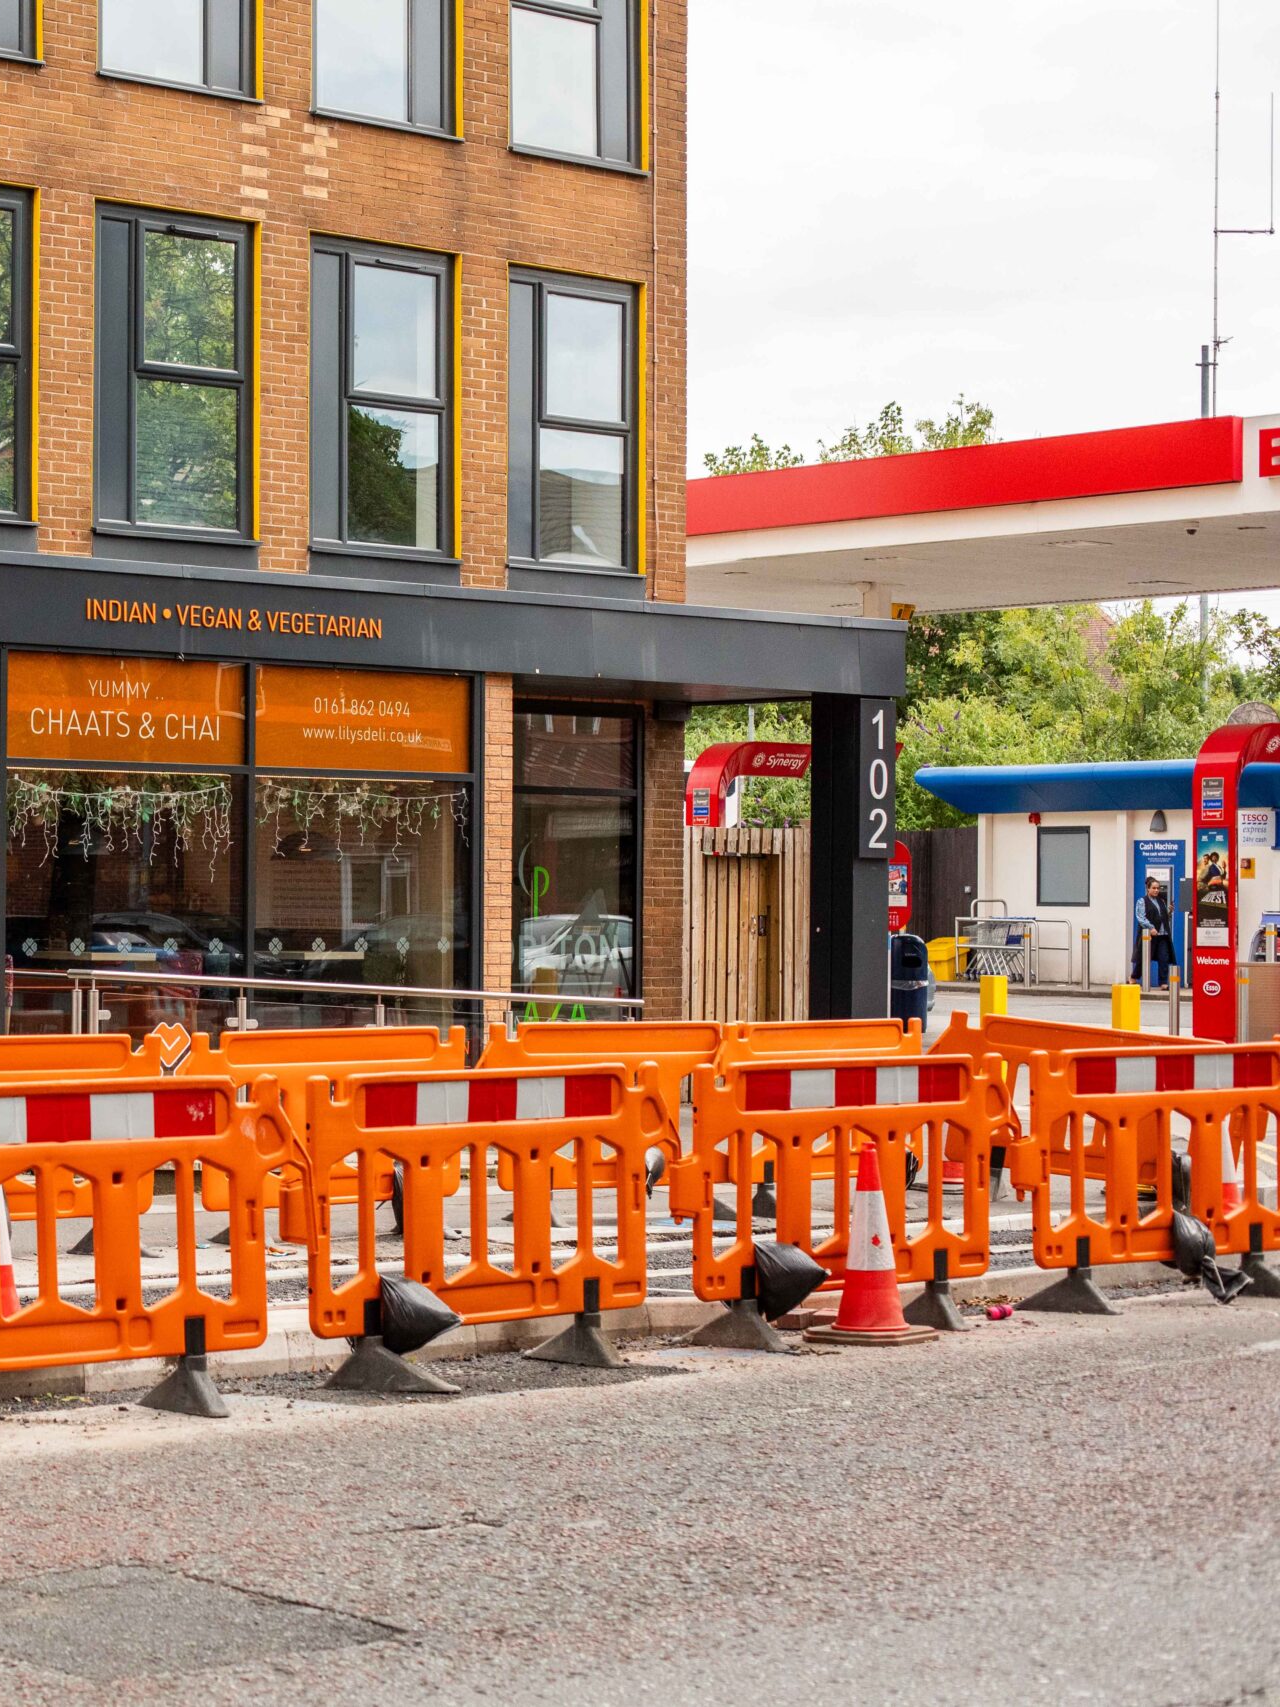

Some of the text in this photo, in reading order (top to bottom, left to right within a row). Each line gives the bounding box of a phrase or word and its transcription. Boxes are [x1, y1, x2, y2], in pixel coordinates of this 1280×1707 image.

[86, 598, 383, 640] INDIAN VEGAN & VEGETARIAN
[313, 697, 411, 718] 0161 862 0494
[30, 707, 220, 741] CHAATS & CHAI
[302, 725, 423, 745] www.lilysdeli.co.uk
[766, 755, 805, 770] Synergy
[868, 709, 889, 849] 102
[1241, 813, 1268, 822] TESCO
[1242, 826, 1267, 835] express
[1139, 842, 1178, 850] Cash Machine
[1196, 956, 1230, 965] Welcome
